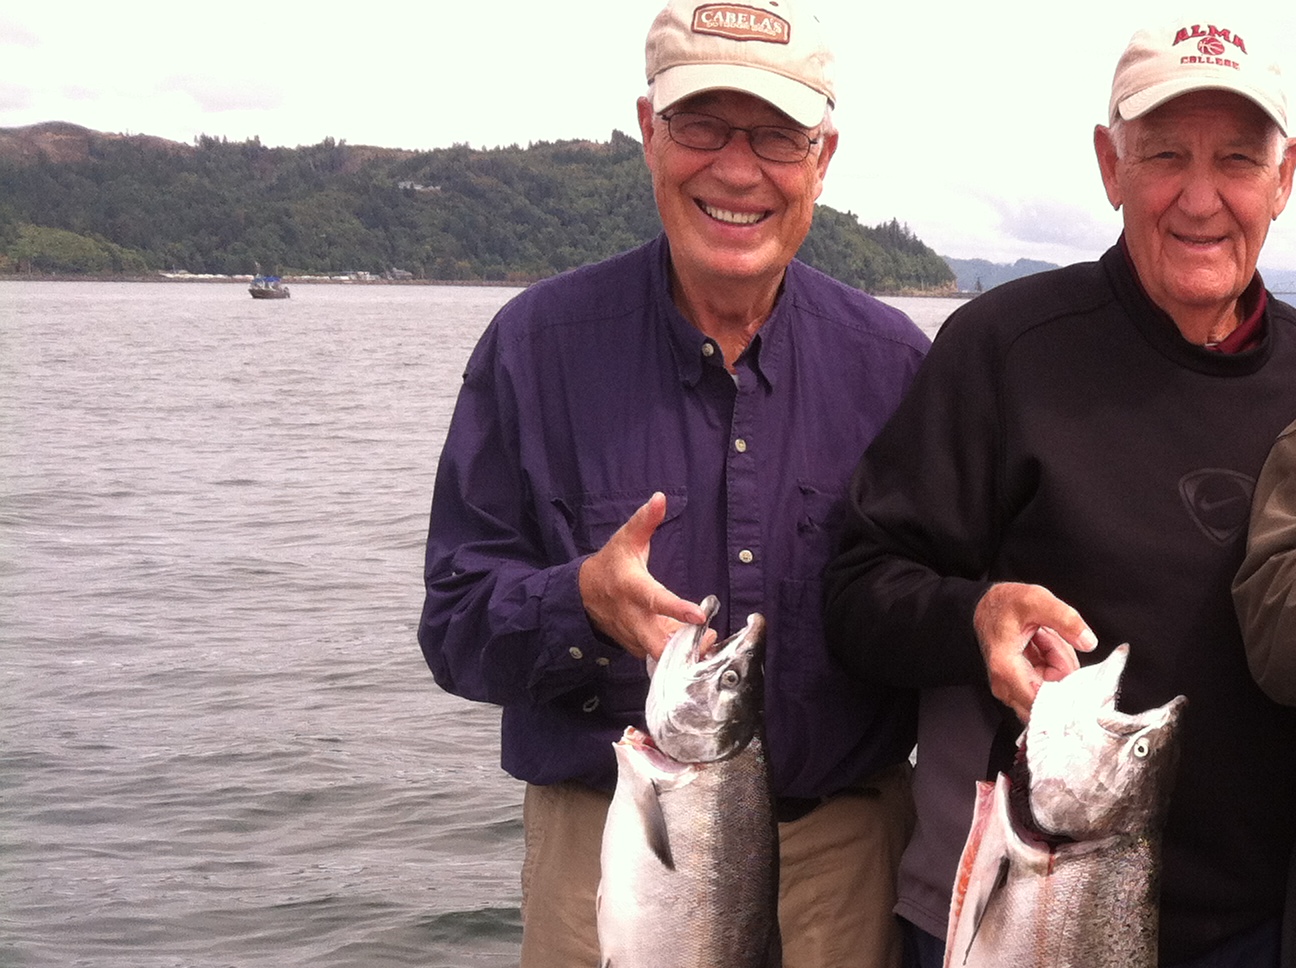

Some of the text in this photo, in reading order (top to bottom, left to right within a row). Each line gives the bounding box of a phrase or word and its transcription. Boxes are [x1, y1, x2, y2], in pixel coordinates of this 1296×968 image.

[701, 11, 783, 34] CABELA'S
[1172, 24, 1248, 55] ALMA
[1180, 55, 1240, 71] COLLEGE
